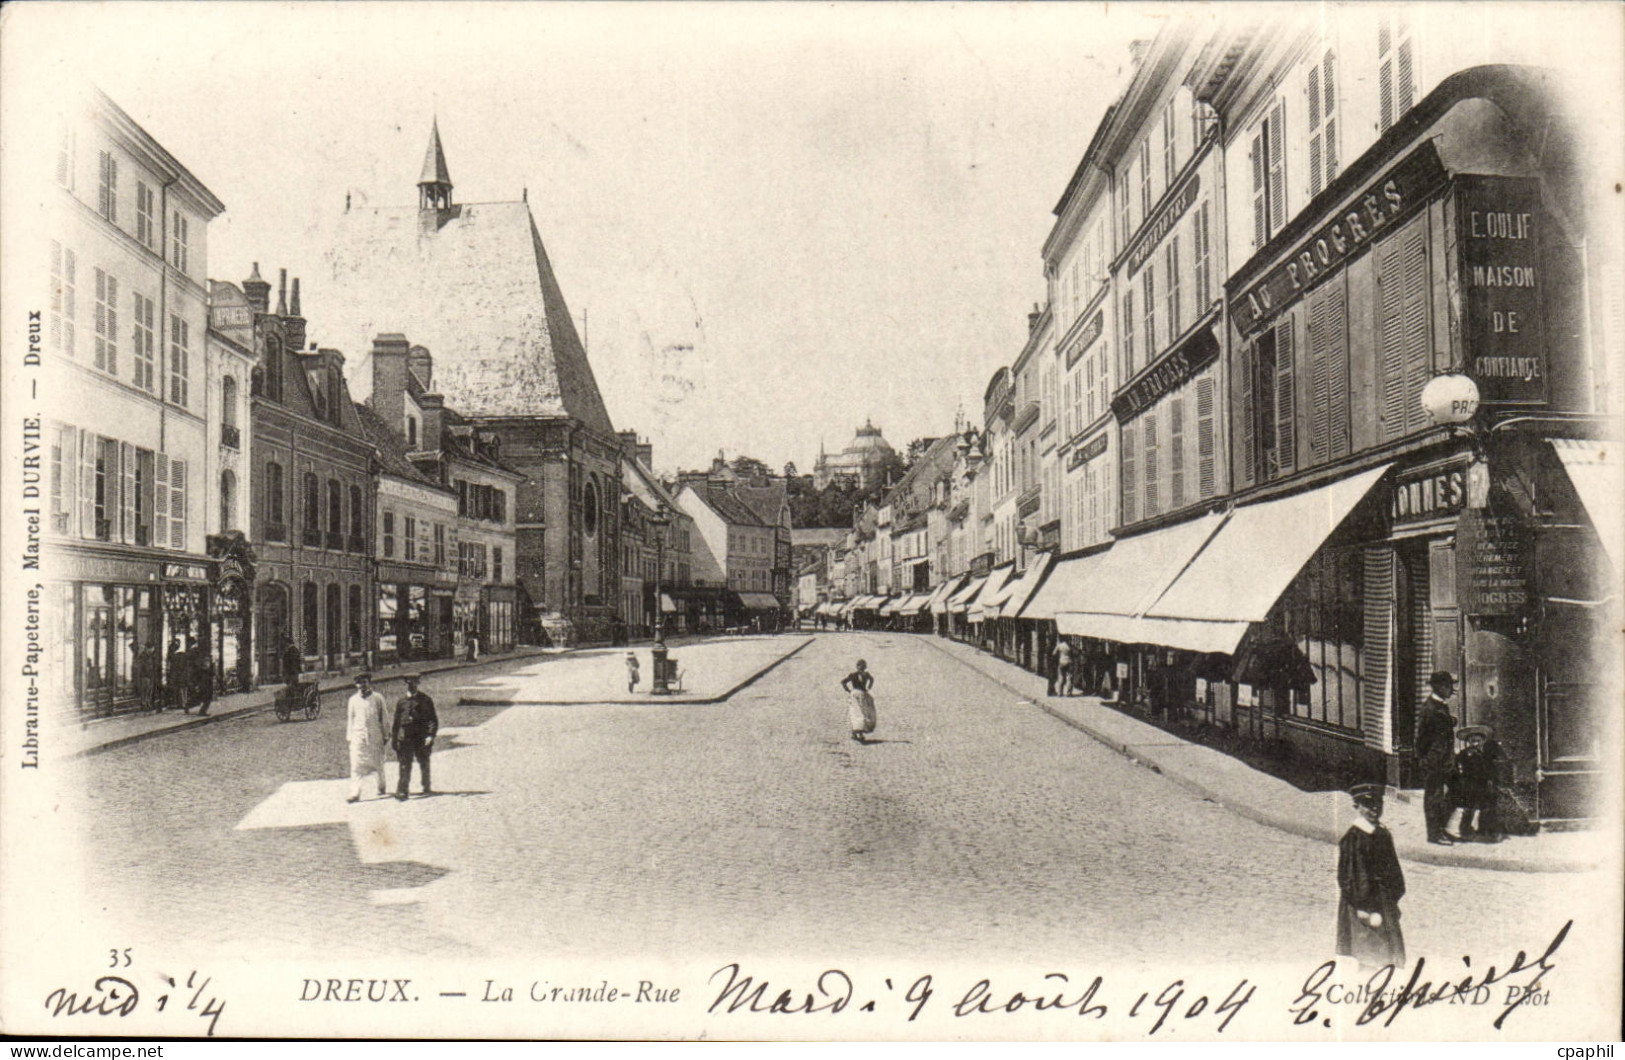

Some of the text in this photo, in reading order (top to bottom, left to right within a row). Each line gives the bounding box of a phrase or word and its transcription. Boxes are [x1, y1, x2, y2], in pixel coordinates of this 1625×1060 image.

[1473, 266, 1535, 287] MAISON
[1248, 284, 1272, 320] AU
[1492, 311, 1519, 332] DE
[905, 974, 933, 1021] 9
[1128, 979, 1258, 1036] 1904
